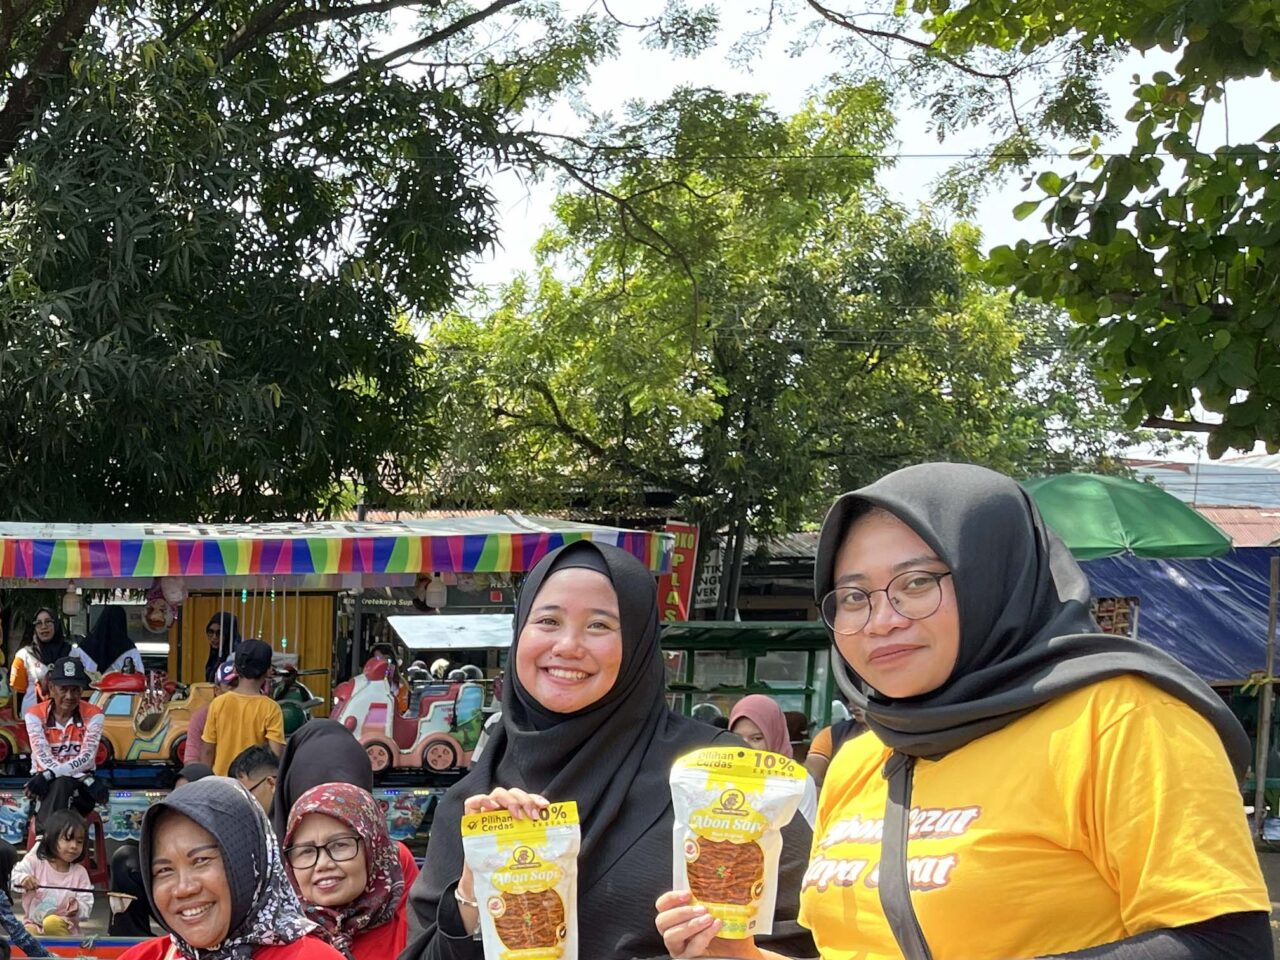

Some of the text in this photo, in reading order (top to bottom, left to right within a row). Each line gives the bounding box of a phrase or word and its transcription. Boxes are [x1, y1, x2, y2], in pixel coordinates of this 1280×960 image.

[698, 750, 795, 772] Pilihan 10%
[481, 814, 513, 825] Pilihan
[533, 805, 567, 822] 0%
[482, 822, 514, 832] Cerdas
[908, 805, 981, 840] ezat
